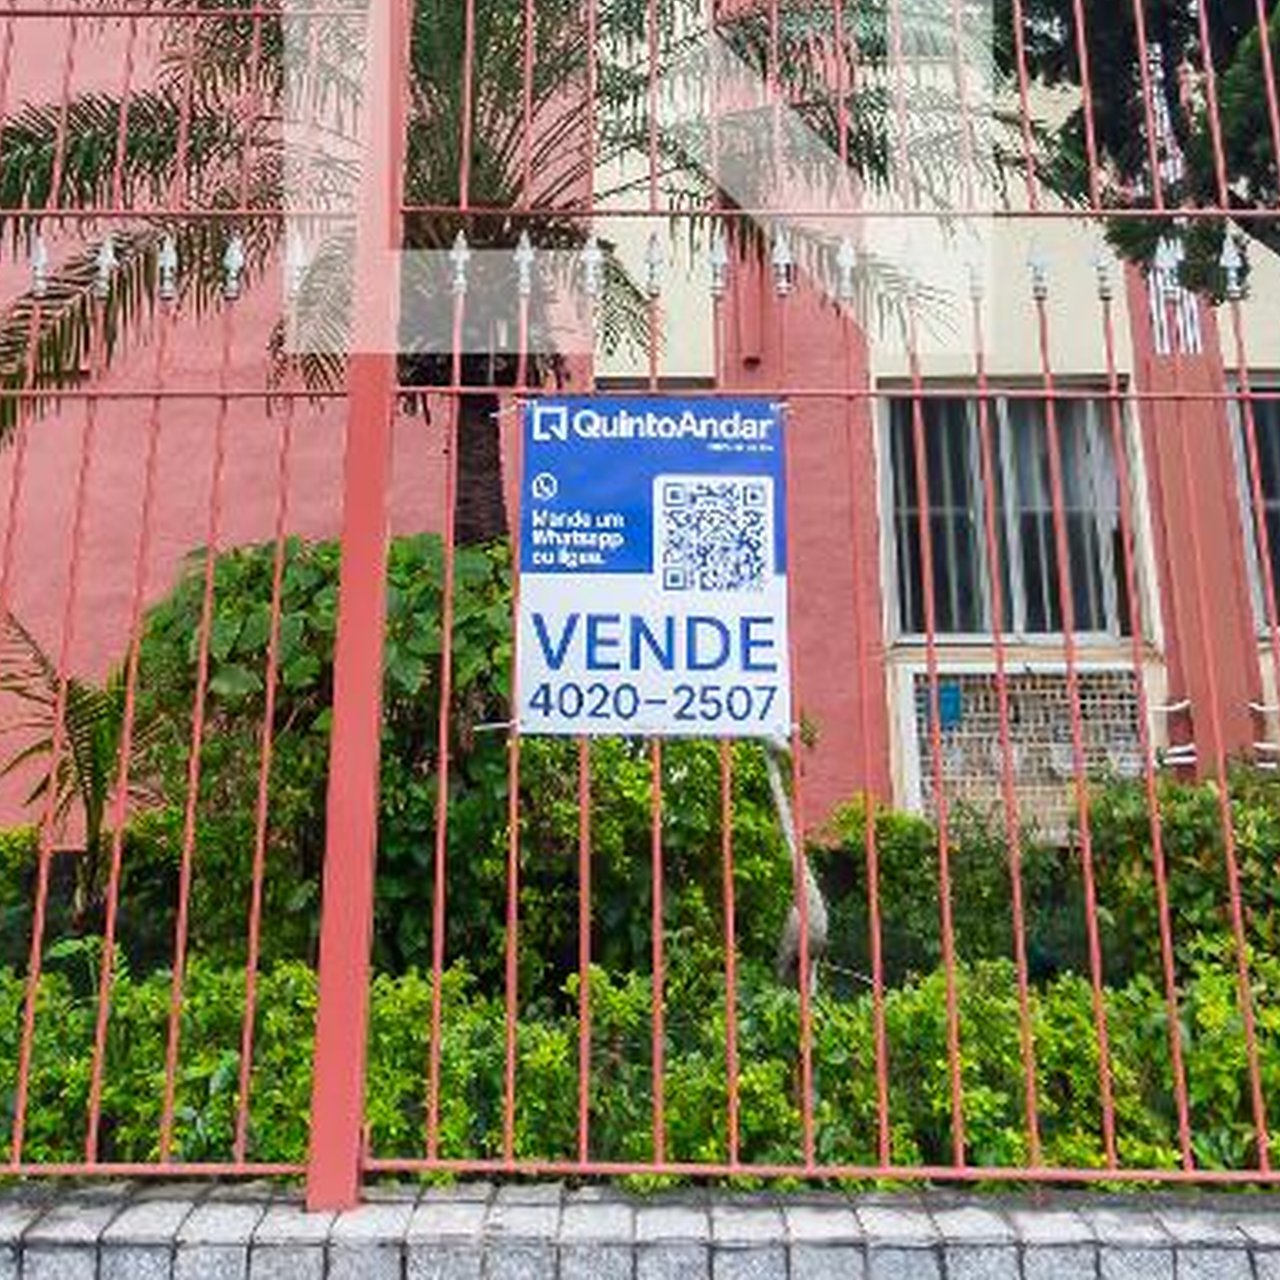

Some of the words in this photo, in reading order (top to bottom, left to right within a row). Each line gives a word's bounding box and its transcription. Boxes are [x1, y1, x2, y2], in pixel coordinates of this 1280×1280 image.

[573, 410, 774, 439] QuintoAndar
[532, 509, 591, 528] Manda
[595, 512, 625, 528] um
[532, 551, 555, 565] ou
[532, 612, 778, 672] VENDE
[529, 683, 778, 721] 4020-2507
